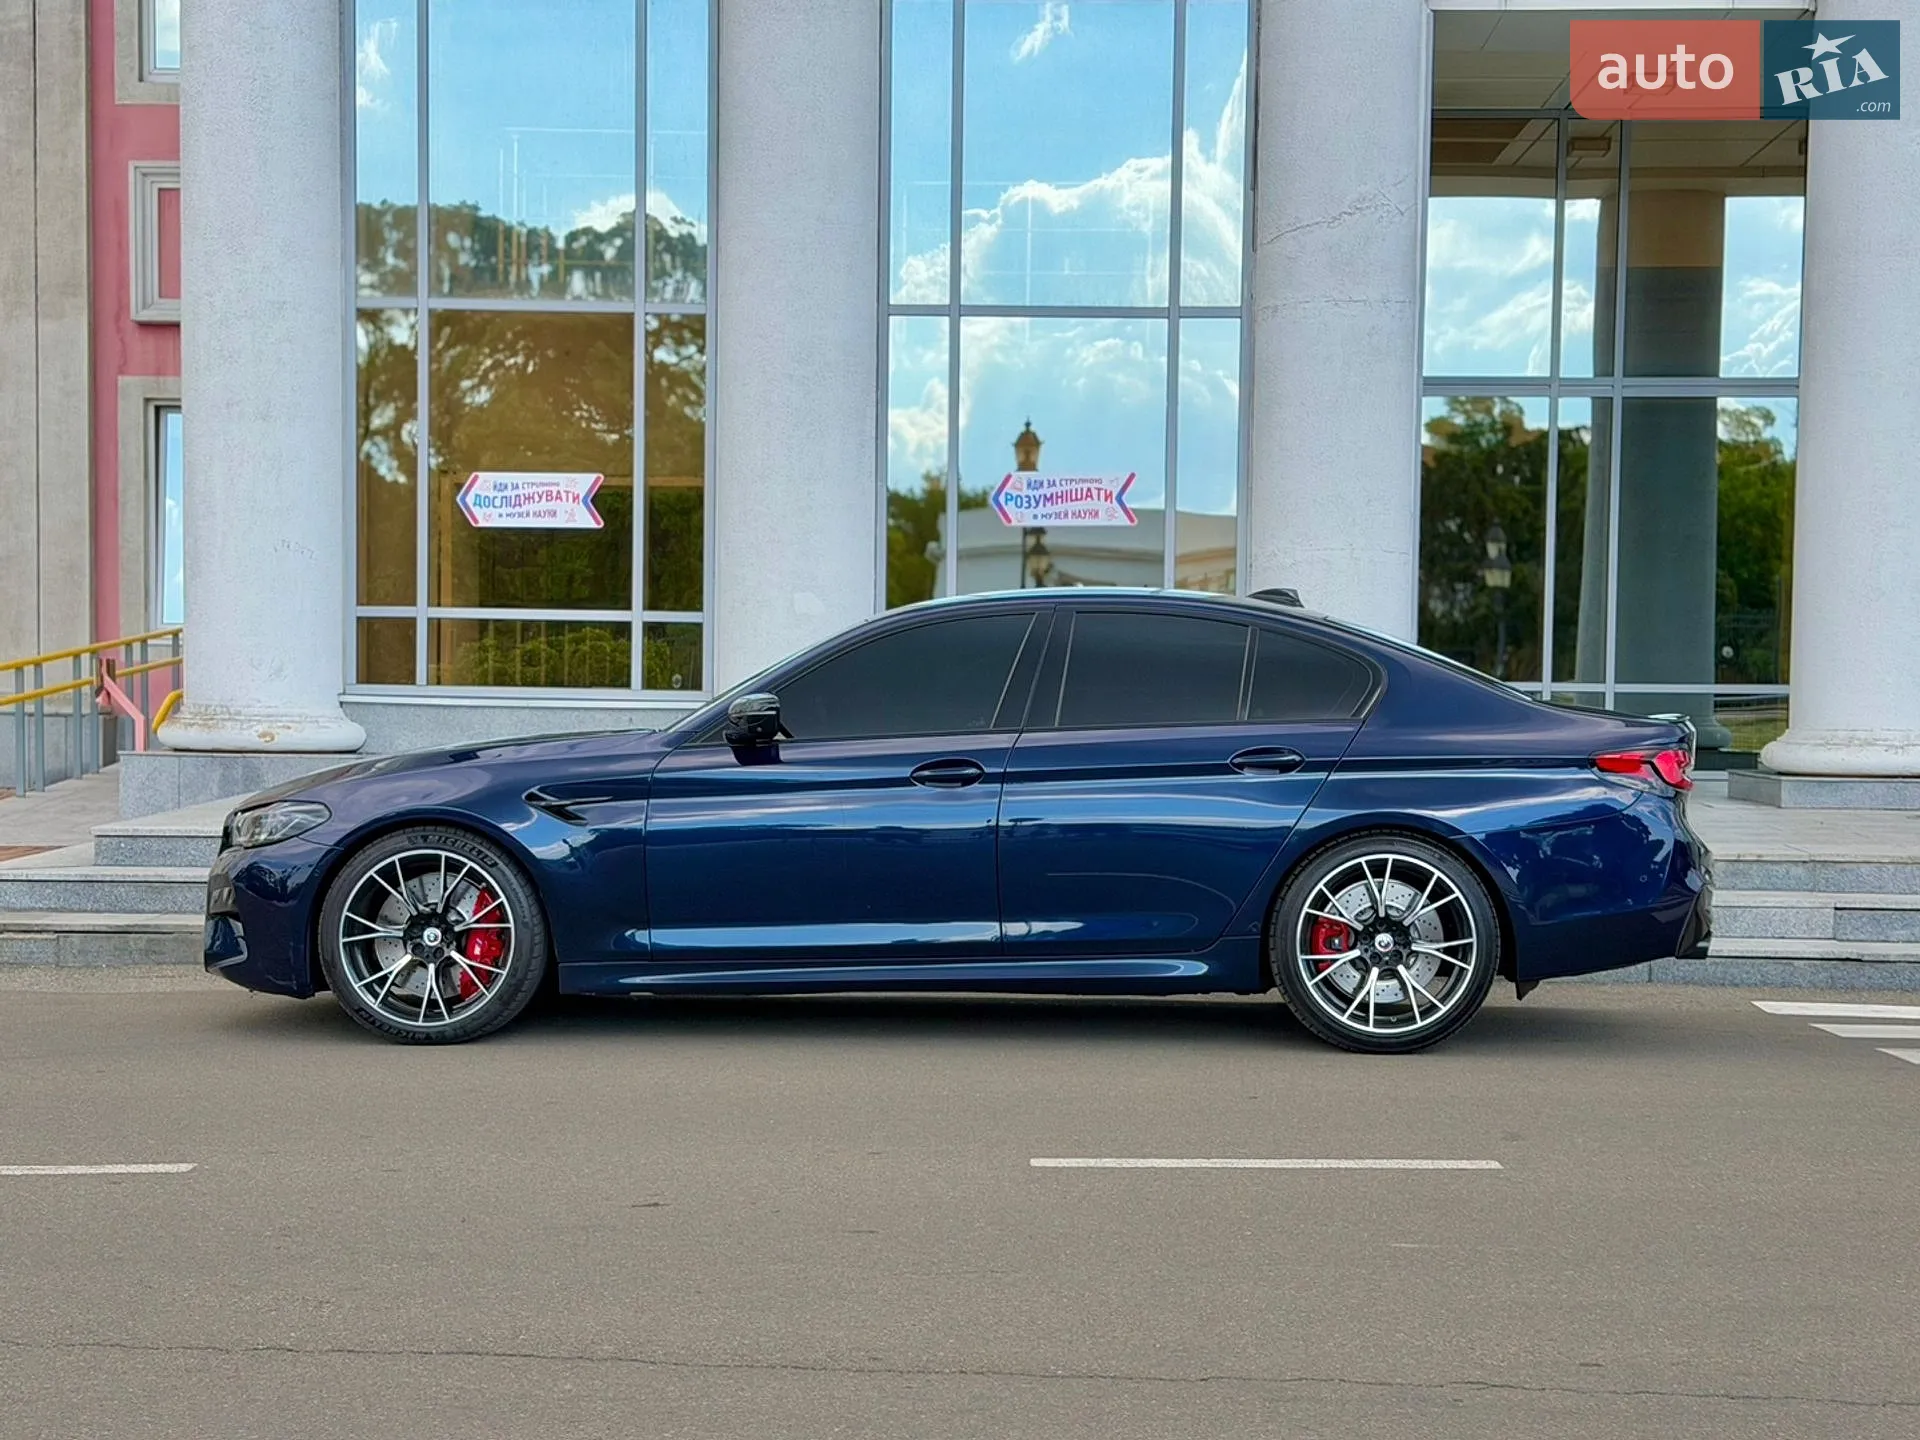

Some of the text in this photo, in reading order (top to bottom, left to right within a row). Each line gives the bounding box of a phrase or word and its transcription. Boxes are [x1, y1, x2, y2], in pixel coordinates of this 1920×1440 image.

[510, 482, 520, 491] ЗА
[1026, 478, 1045, 491] ЙДИ
[1046, 478, 1057, 489] ЗА
[473, 489, 581, 510] ДОСЛІДЖУВАТИ
[1005, 487, 1113, 510] РОЗУМНІШАТИ
